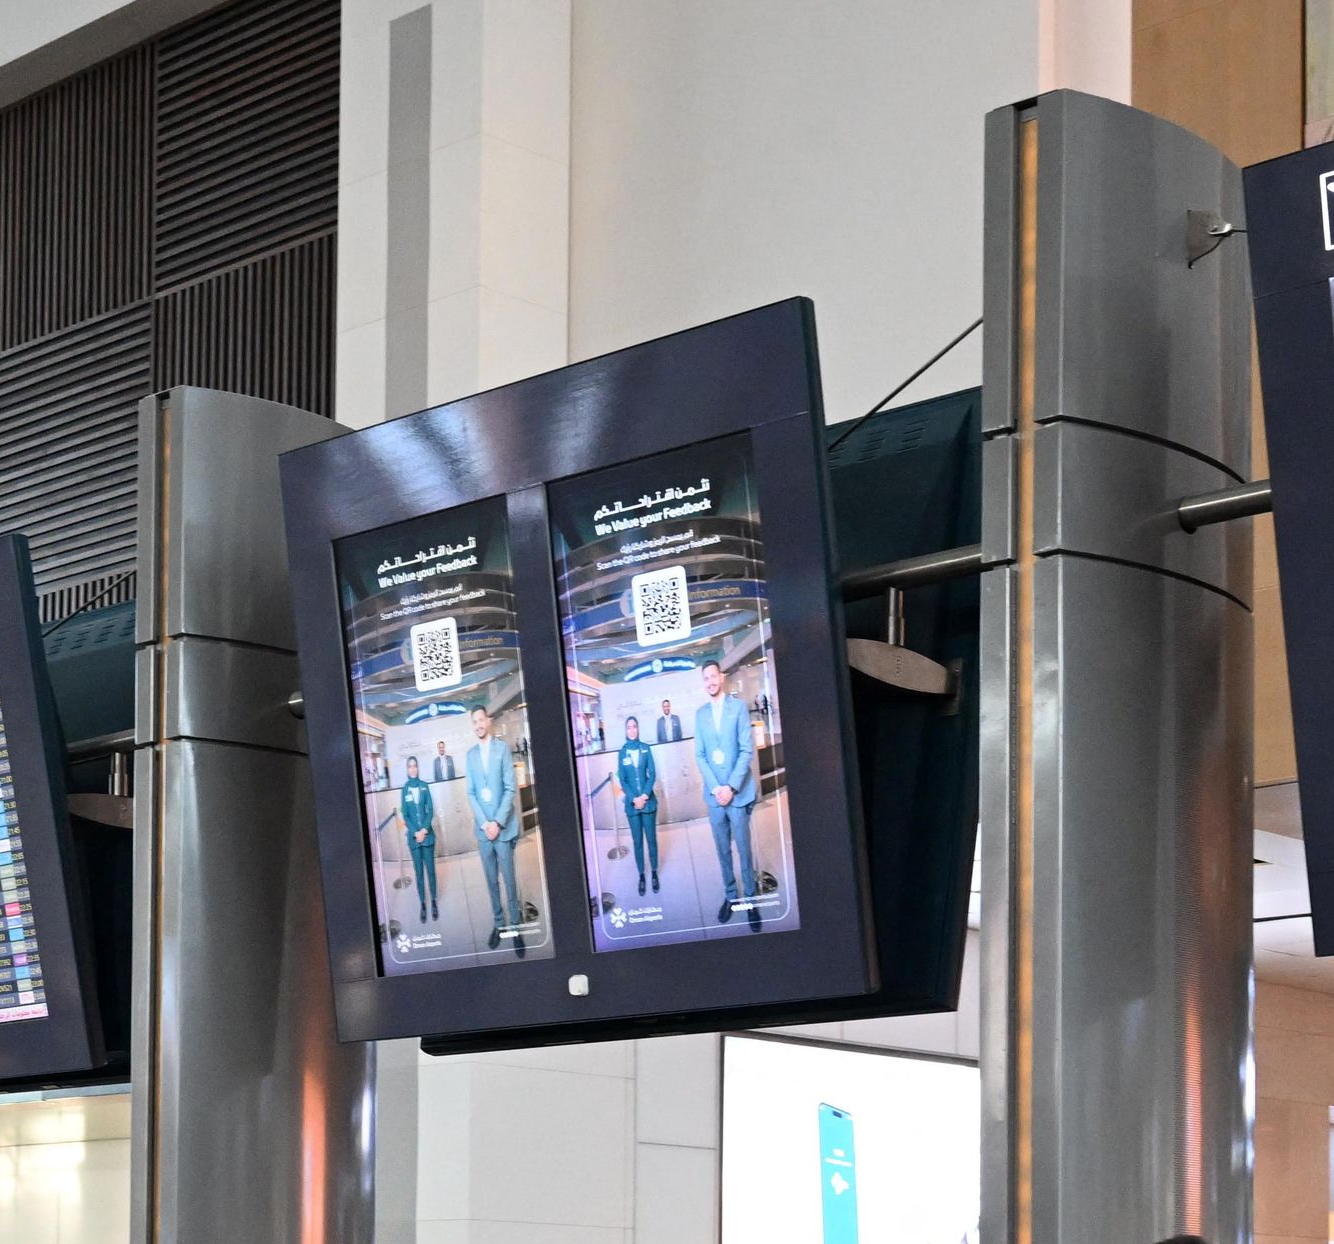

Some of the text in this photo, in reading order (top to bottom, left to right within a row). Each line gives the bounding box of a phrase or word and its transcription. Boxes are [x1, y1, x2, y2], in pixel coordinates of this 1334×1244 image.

[595, 498, 711, 536] We Value your Feedback
[378, 555, 478, 589] We Value your Feedback
